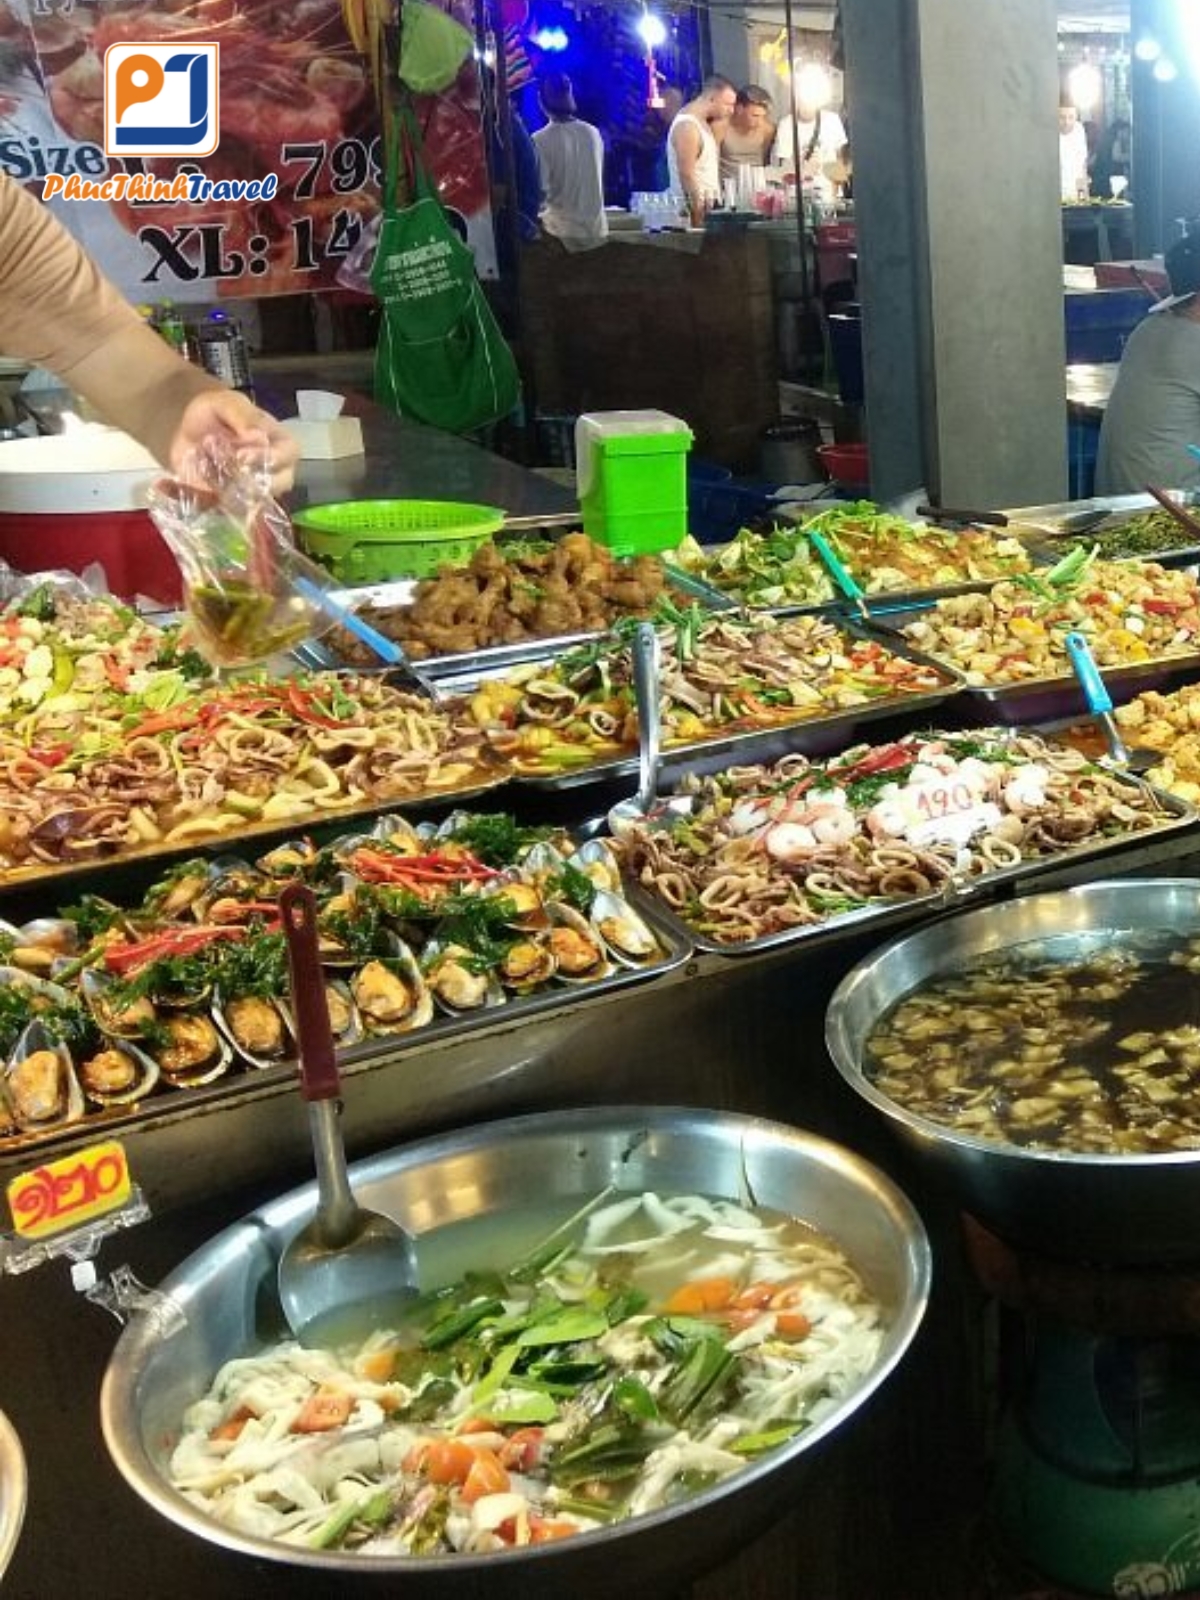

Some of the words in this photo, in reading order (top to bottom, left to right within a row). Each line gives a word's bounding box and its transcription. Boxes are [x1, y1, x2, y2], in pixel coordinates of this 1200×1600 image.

[0, 136, 106, 178] Size
[139, 223, 268, 282] XL:
[917, 783, 973, 819] 190
